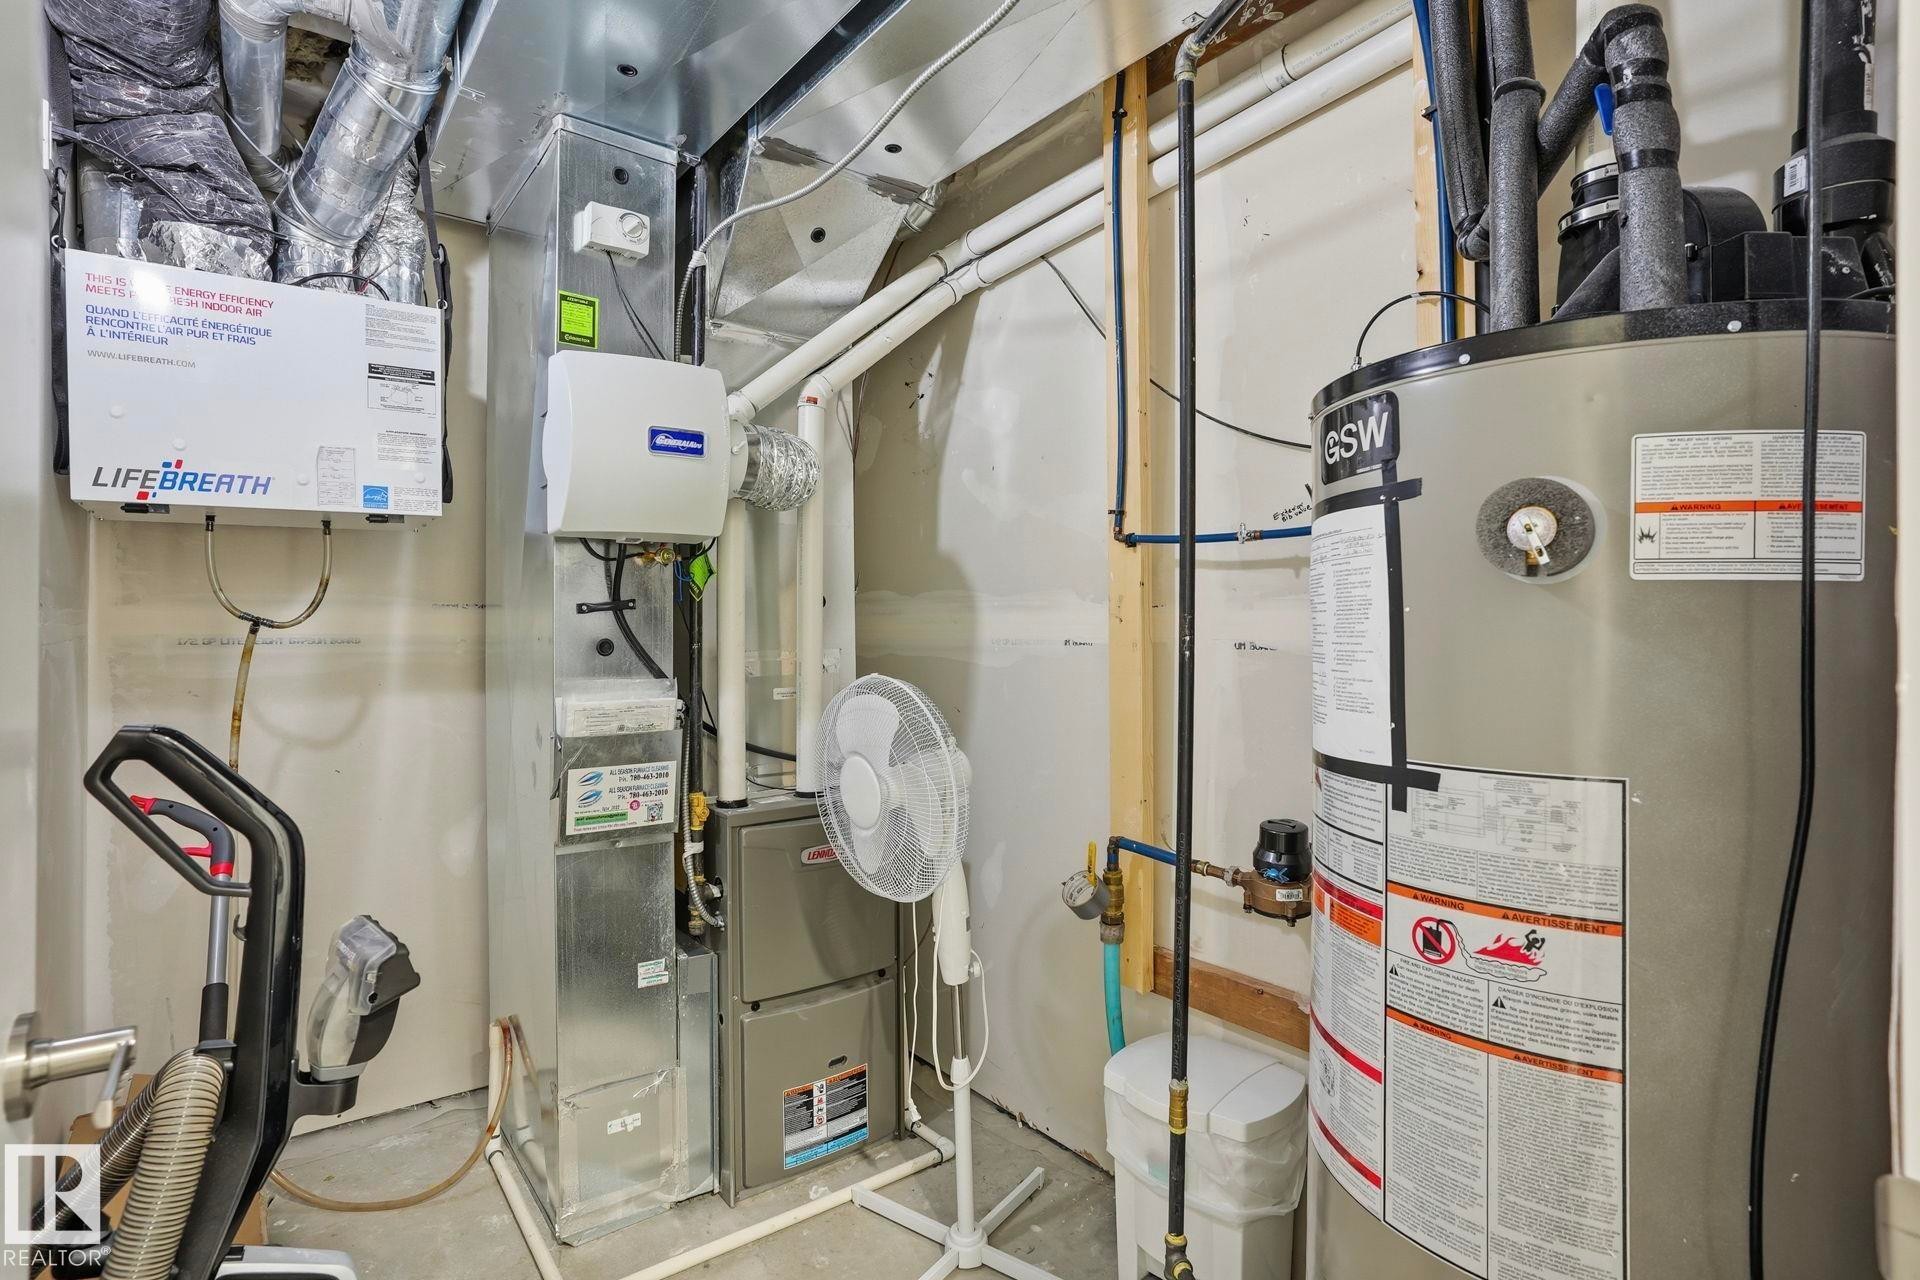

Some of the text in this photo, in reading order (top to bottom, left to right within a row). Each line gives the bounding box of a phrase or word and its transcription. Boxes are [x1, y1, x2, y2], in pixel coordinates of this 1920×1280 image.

[85, 272, 113, 285] THIS
[115, 277, 127, 287] IS
[174, 286, 217, 301] ENERGY
[219, 293, 274, 310] EFFICIENCY
[85, 283, 126, 299] MEETS
[202, 300, 243, 315] INDOOR
[245, 307, 263, 318] AIR
[85, 304, 273, 338] QUAND L'EFFICACITÉ ÉNERGÉTIQUE
[85, 316, 256, 346] RENCONTRE L'AIR PUR ET FRAIS
[100, 328, 169, 346] L'INTÉRIEUR
[87, 350, 196, 369] WWW.LIFEBREATH.COM
[1324, 411, 1389, 466] GSW
[92, 466, 272, 495] LIFEBREATH
[1679, 503, 1722, 511] WARNING
[630, 771, 670, 781] 780-463-2010
[629, 789, 669, 799] 780-463-2010
[1420, 893, 1465, 911] WARNING
[1510, 913, 1607, 934] AVERTISSEMENT
[1421, 965, 1450, 978] EXPLOSION
[1451, 973, 1475, 986] HAZARD
[1497, 985, 1523, 997] DANGER
[1525, 991, 1559, 1004] D'INCENDIE
[1574, 1000, 1619, 1015] D'EXPLOSION
[1419, 1023, 1452, 1040] WARNING
[1522, 1055, 1595, 1078] AVERTISSEMENT
